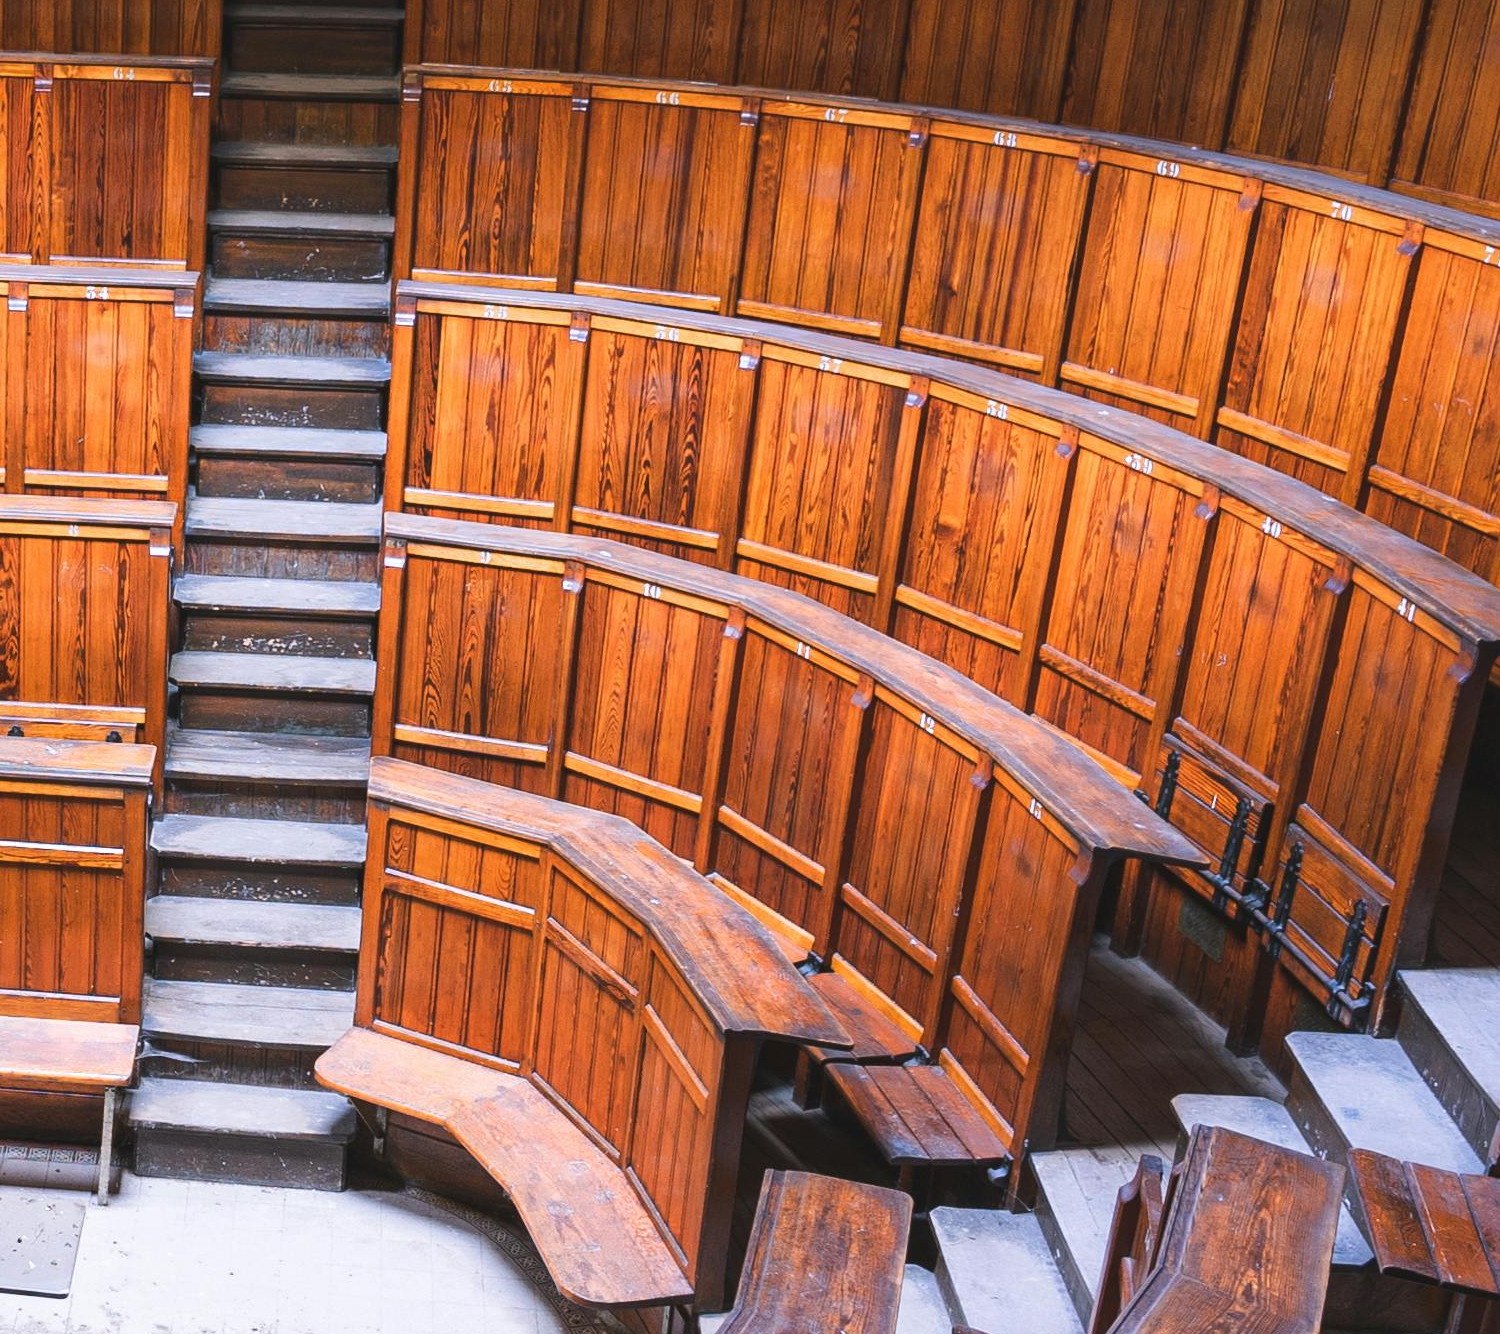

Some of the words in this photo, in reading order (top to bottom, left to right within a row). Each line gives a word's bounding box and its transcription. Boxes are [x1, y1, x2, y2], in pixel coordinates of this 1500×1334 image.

[113, 69, 135, 80] 64
[489, 81, 512, 93] 65
[655, 92, 679, 105] 66
[823, 109, 848, 122] 67
[993, 132, 1016, 147] 68
[1157, 161, 1179, 177] 69
[1330, 202, 1352, 220] 70
[86, 287, 109, 299] 34
[819, 357, 842, 373] 37
[985, 401, 1008, 419] 38
[1130, 453, 1153, 476] 39
[1262, 517, 1281, 537] 40
[480, 551, 492, 564] 9
[641, 584, 661, 598] 10
[1397, 598, 1416, 621] 41
[795, 643, 811, 659] 11
[920, 714, 934, 734] 12
[1030, 798, 1042, 819] 13
